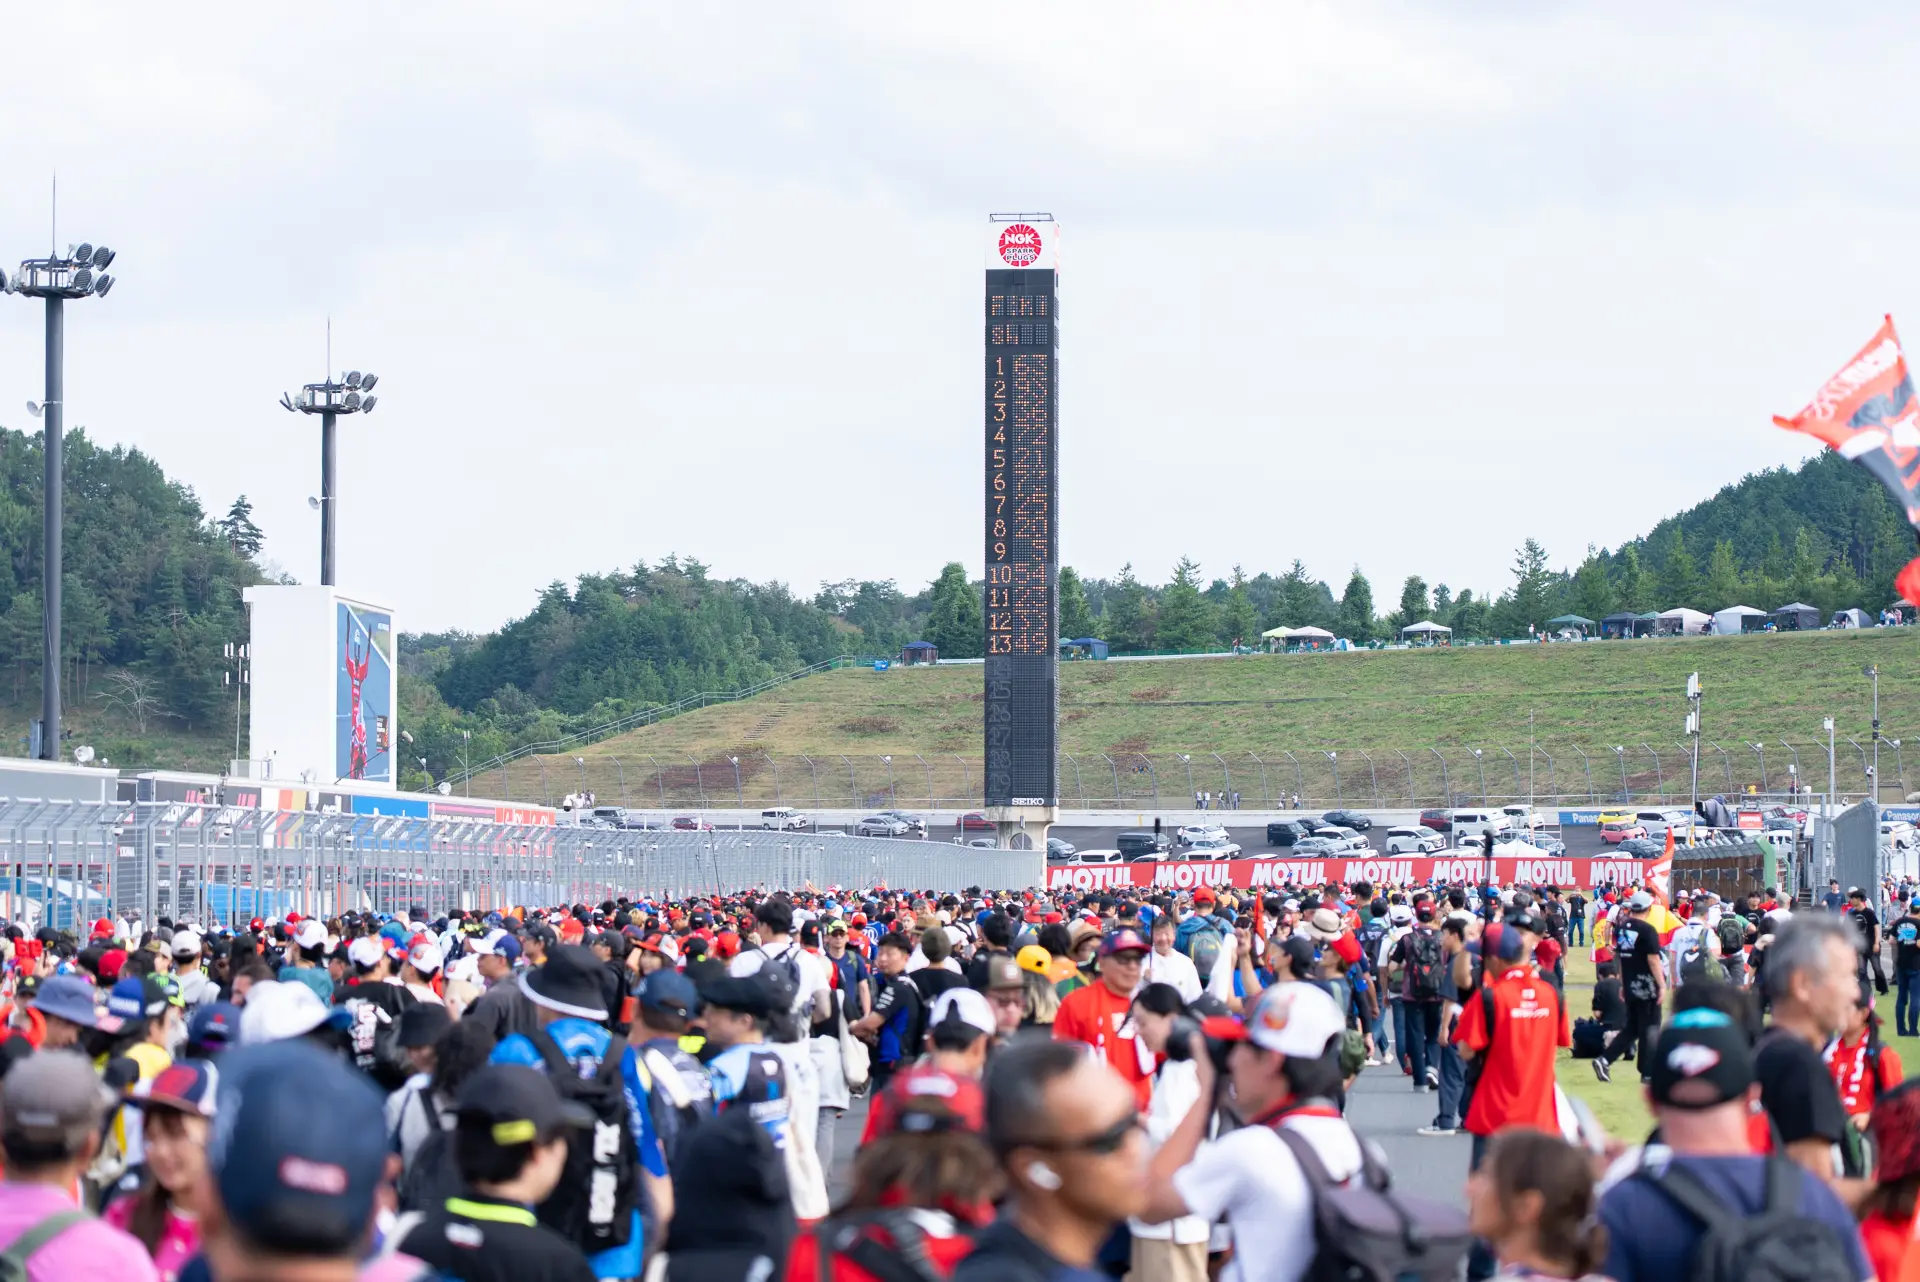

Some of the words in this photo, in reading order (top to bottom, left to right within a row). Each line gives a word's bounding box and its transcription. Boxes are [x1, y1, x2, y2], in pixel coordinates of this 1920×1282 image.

[1004, 233, 1035, 245] NGK
[996, 356, 1004, 375] 1
[993, 380, 1006, 399] 2
[993, 403, 1006, 422] 3
[993, 425, 1006, 444] 4
[993, 449, 1006, 468] 5
[993, 472, 1006, 491] 6
[993, 496, 1006, 514] 7
[993, 518, 1006, 537] 8
[994, 542, 1006, 561] 9
[1032, 539, 1048, 560] 5
[990, 565, 1012, 584] 10
[1015, 562, 1048, 584] 54
[990, 588, 1010, 607] 11
[990, 612, 1012, 630] 12
[990, 634, 1012, 653] 13
[1011, 797, 1045, 806] SEIKO
[1050, 866, 1134, 891] MOTUL
[1154, 863, 1232, 887] MOTUL
[1250, 861, 1326, 887] MOTUL
[1344, 861, 1414, 885] MOTUL
[1432, 860, 1500, 886] MOTUL
[1514, 860, 1576, 886] MOTUL
[1589, 861, 1646, 887] MOTUL
